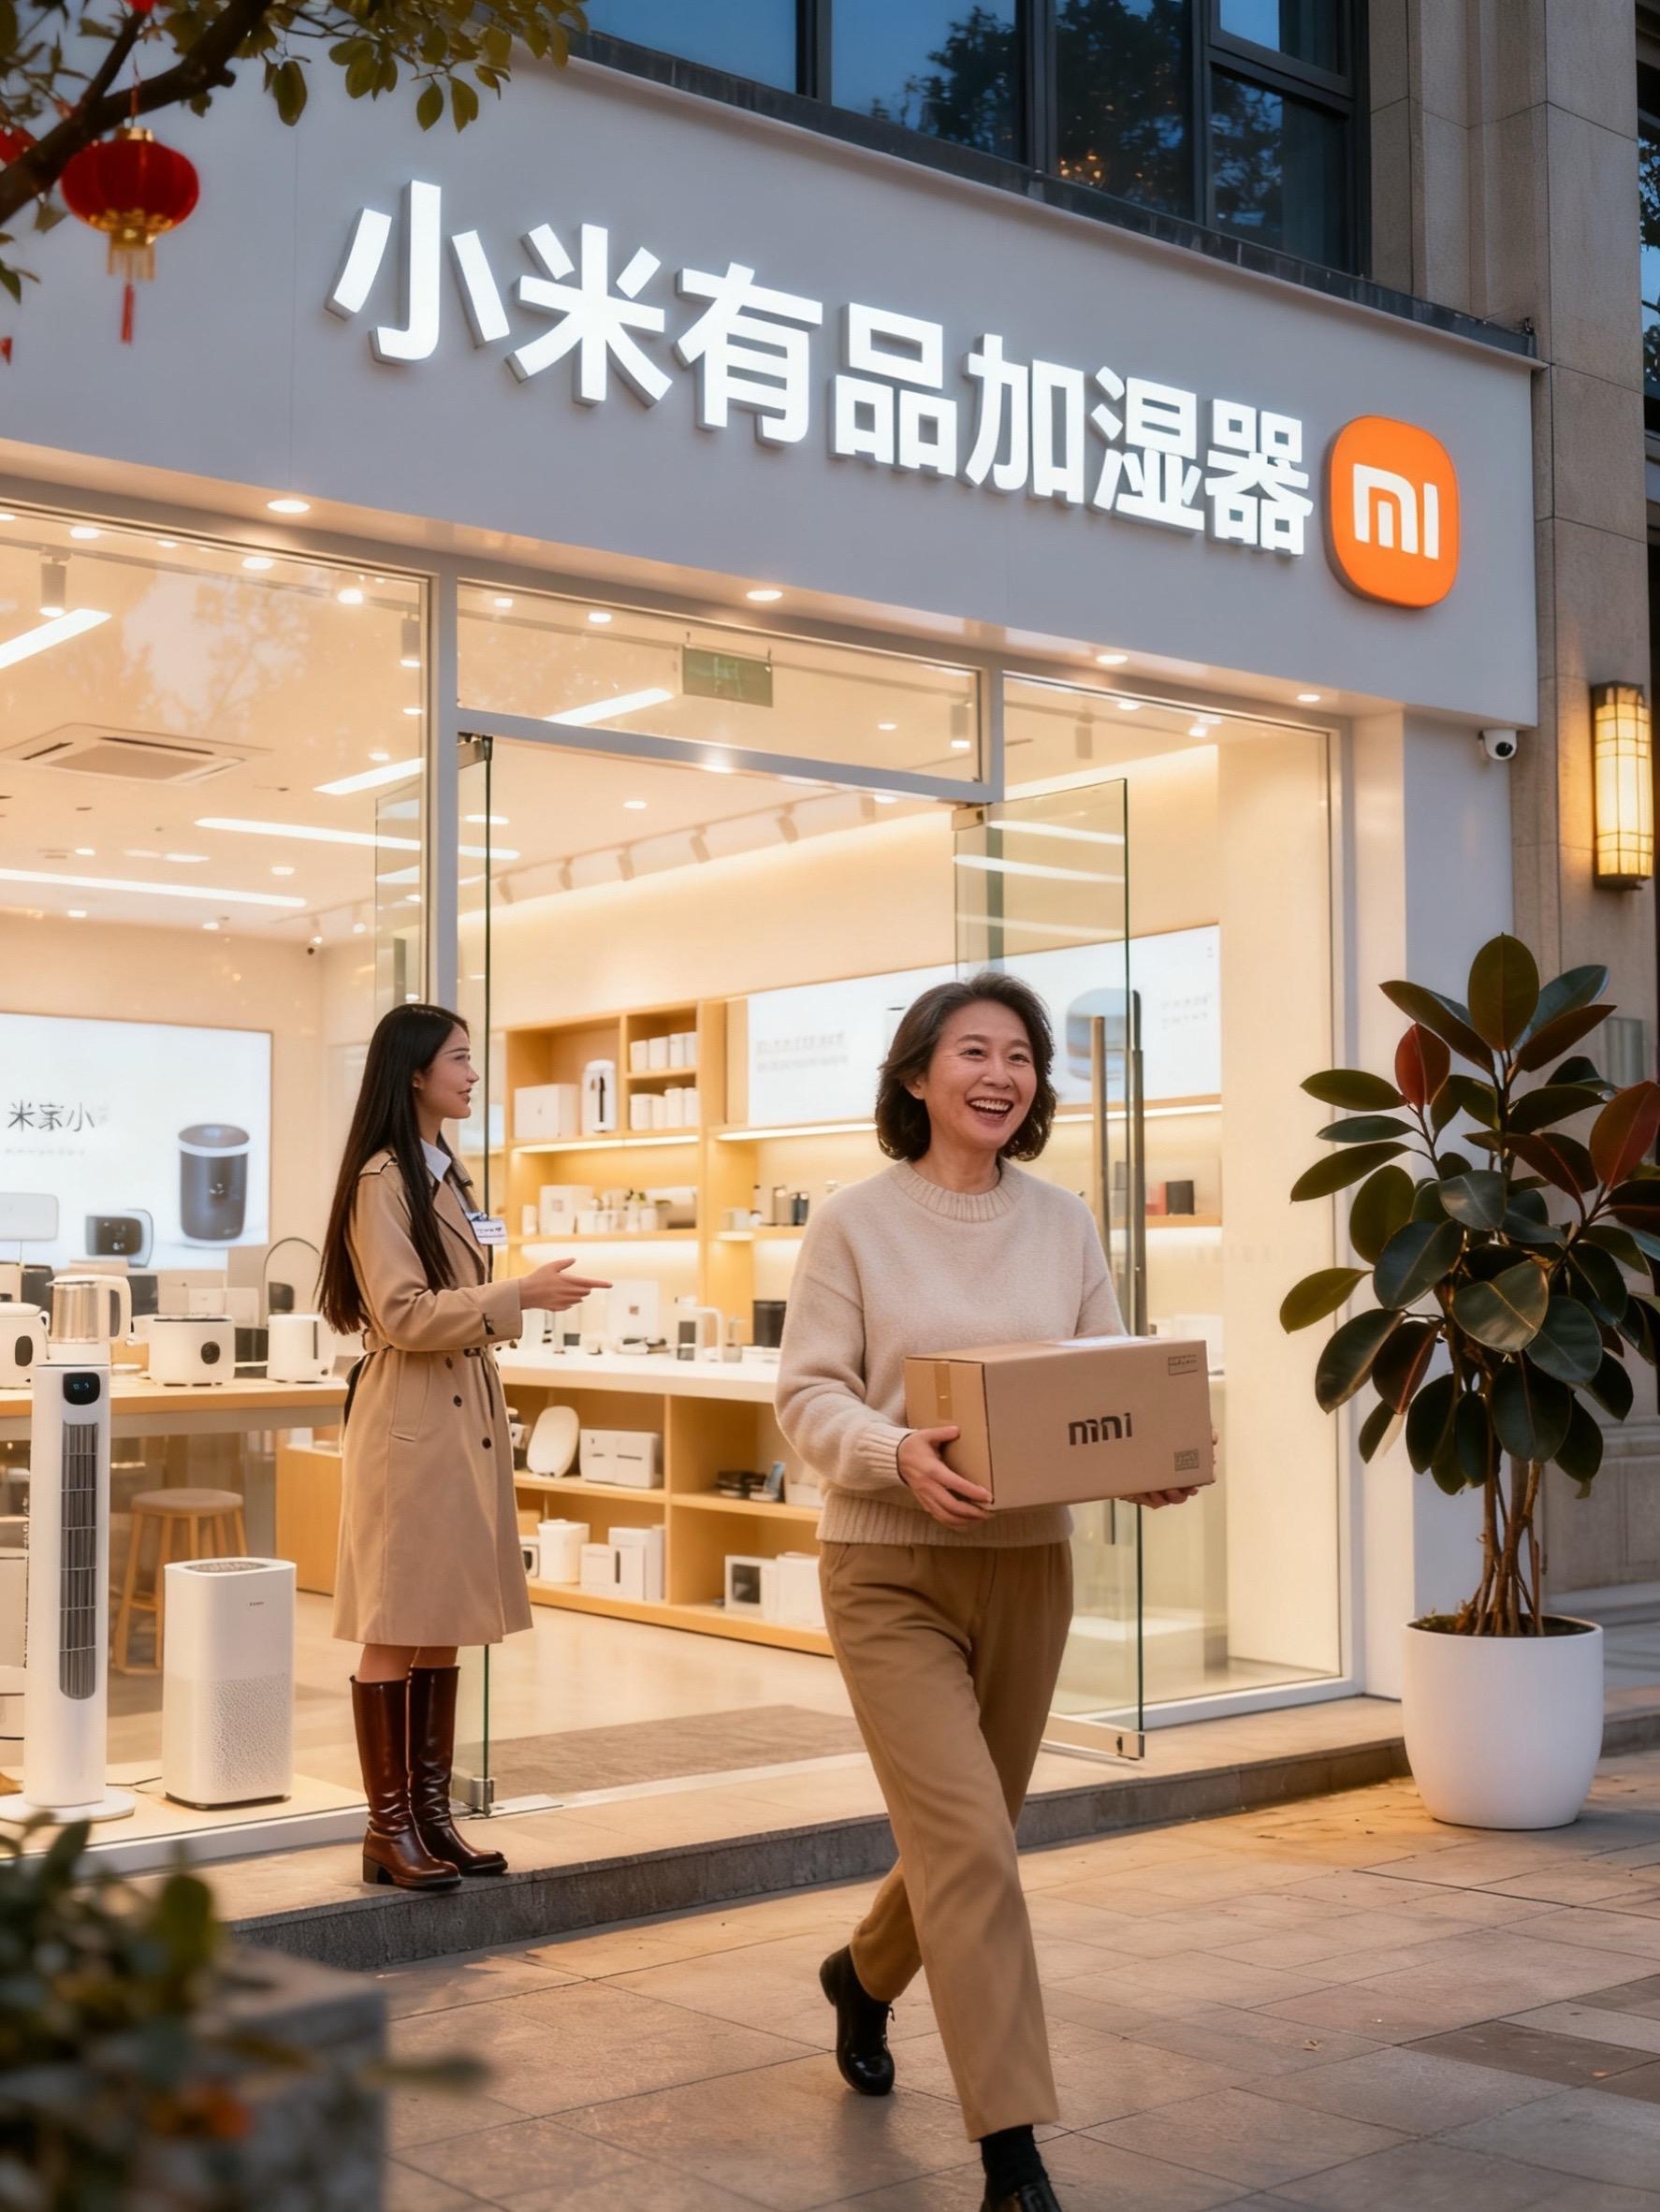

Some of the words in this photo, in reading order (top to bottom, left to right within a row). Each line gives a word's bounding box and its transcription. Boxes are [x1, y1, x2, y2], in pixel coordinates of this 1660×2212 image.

[327, 180, 1314, 557] 小米有品加湿器
